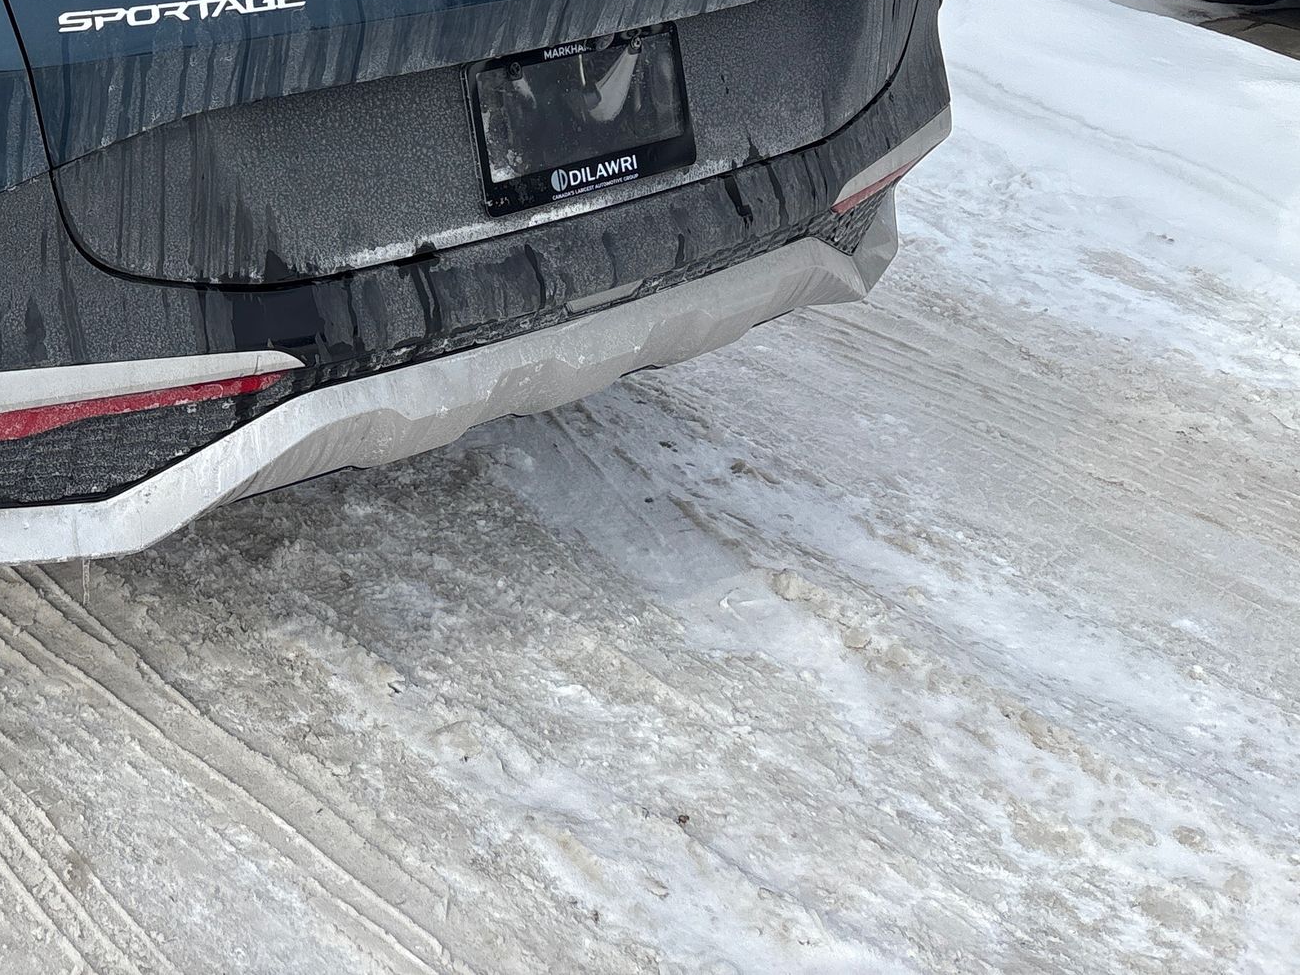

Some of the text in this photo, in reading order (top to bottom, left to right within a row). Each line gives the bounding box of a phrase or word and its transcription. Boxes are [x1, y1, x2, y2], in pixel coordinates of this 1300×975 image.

[543, 43, 591, 60] MARKHA
[568, 154, 638, 186] DILAWRI
[623, 172, 639, 182] GROUP
